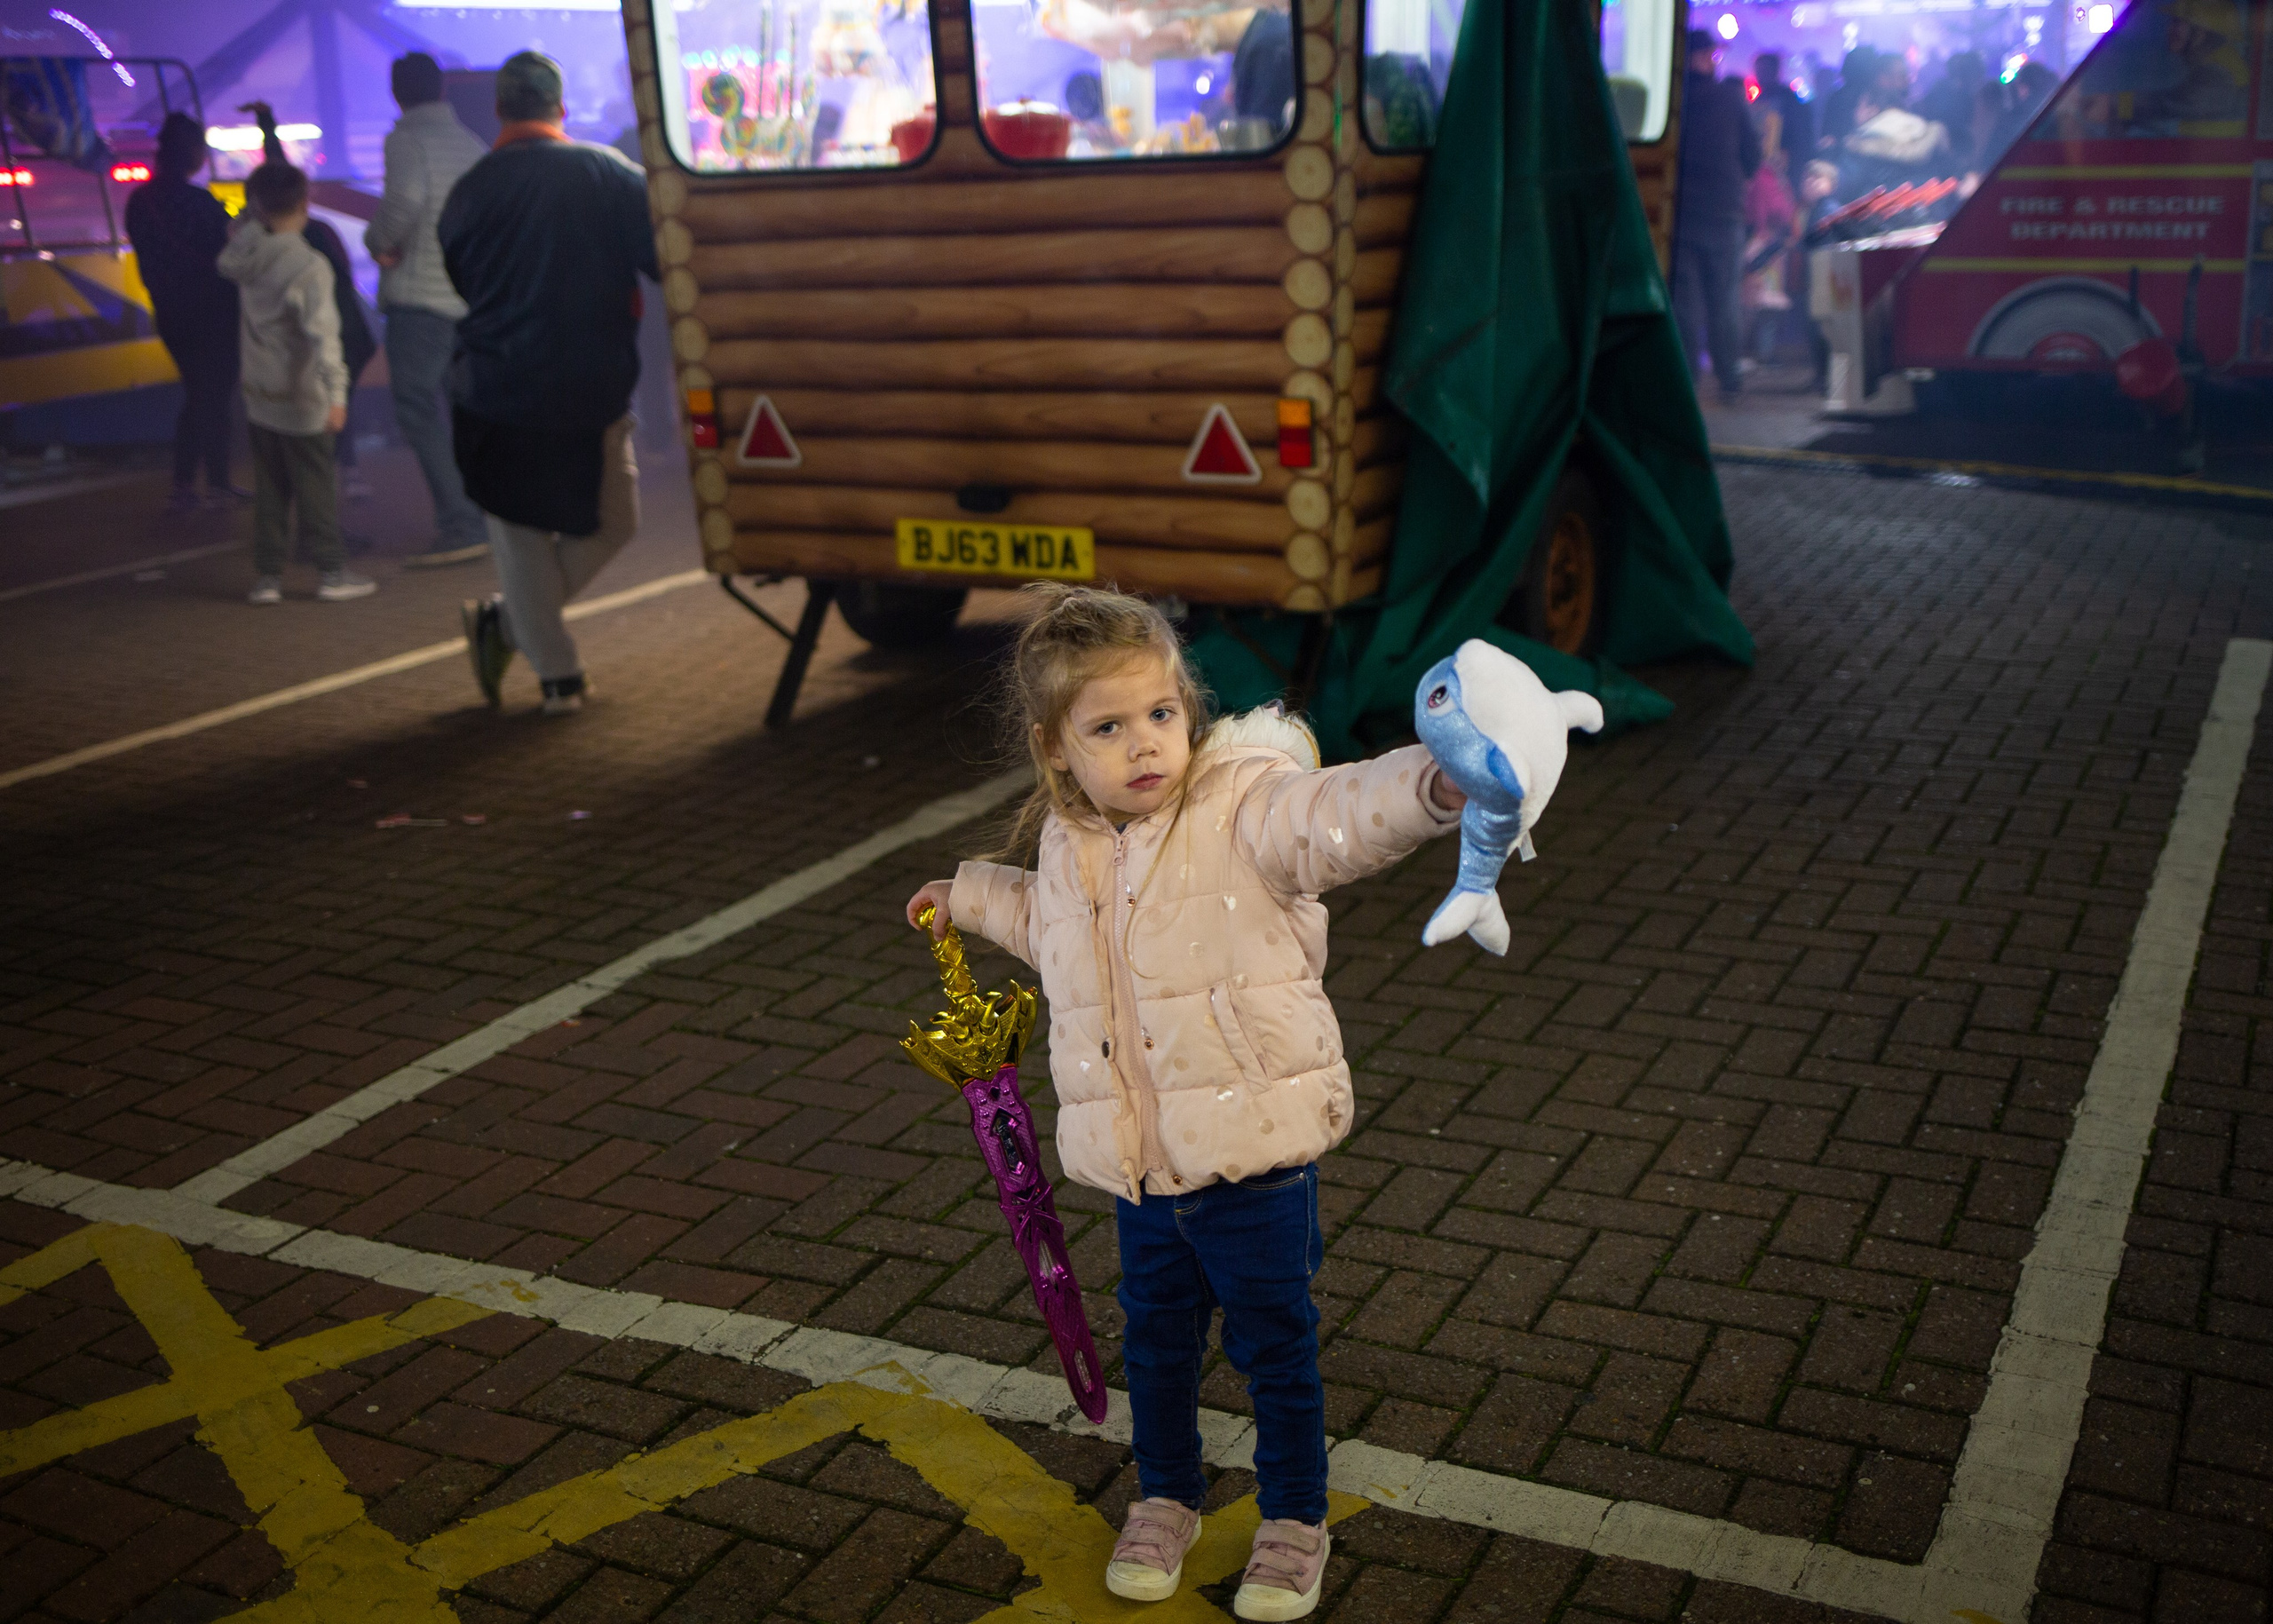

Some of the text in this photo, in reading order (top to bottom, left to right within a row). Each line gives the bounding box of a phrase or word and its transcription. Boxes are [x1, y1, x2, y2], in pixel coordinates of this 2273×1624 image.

[2000, 195, 2224, 214] FIRE & RESCUE
[2010, 222, 2208, 240] DEPARTMENT
[913, 527, 1081, 571] BJ63 WDA
